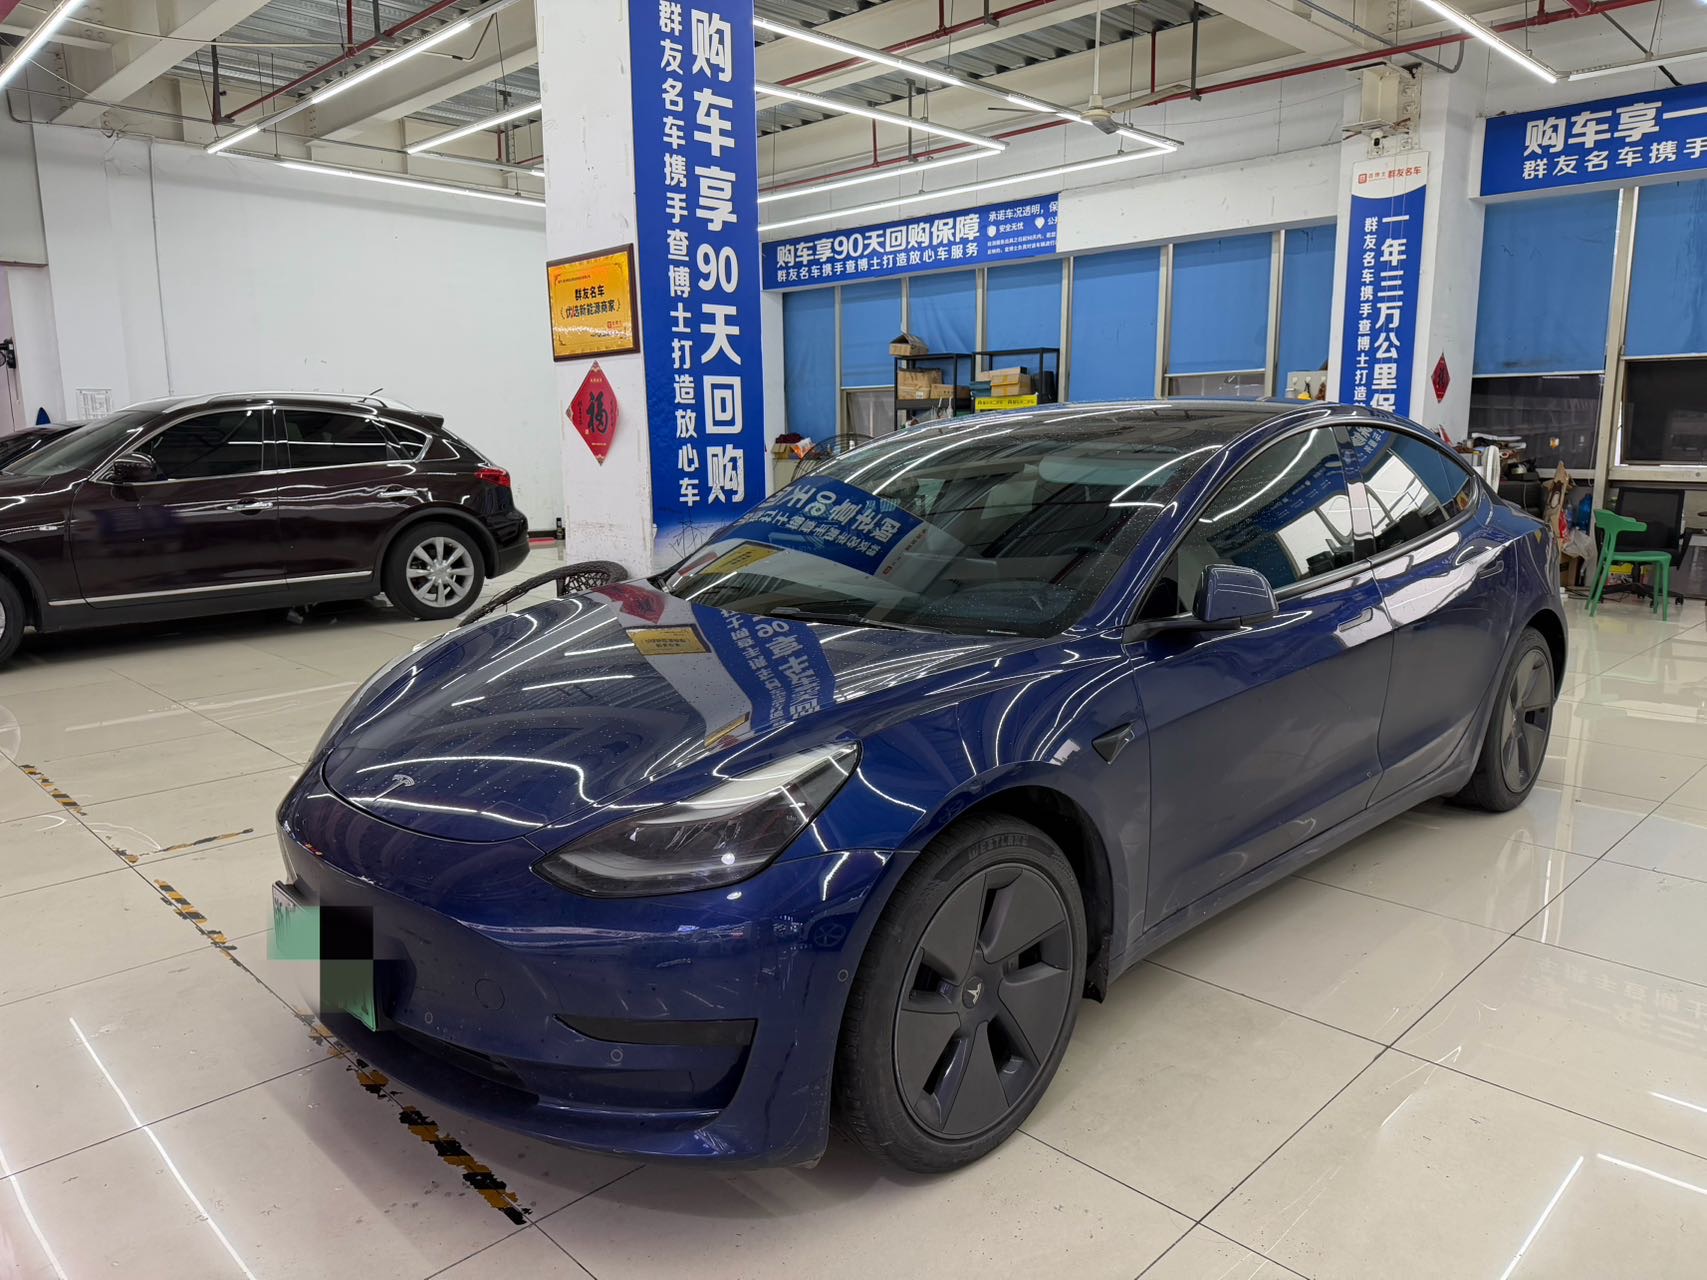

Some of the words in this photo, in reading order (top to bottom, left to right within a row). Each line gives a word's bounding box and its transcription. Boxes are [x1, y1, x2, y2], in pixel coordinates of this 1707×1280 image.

[1524, 101, 1707, 157] 购车享一
[1523, 136, 1707, 180] 群友名车携手
[659, 0, 701, 507] 群友名车携手查博士打造放心车
[691, 9, 745, 504] 购车享90天回购
[777, 214, 980, 268] 购车享90天回购保障
[777, 243, 979, 282] 群友名车携手查博士打造放心车服务
[574, 284, 605, 301] 群友名车
[1353, 216, 1378, 407] 群友名车携手查博士打造
